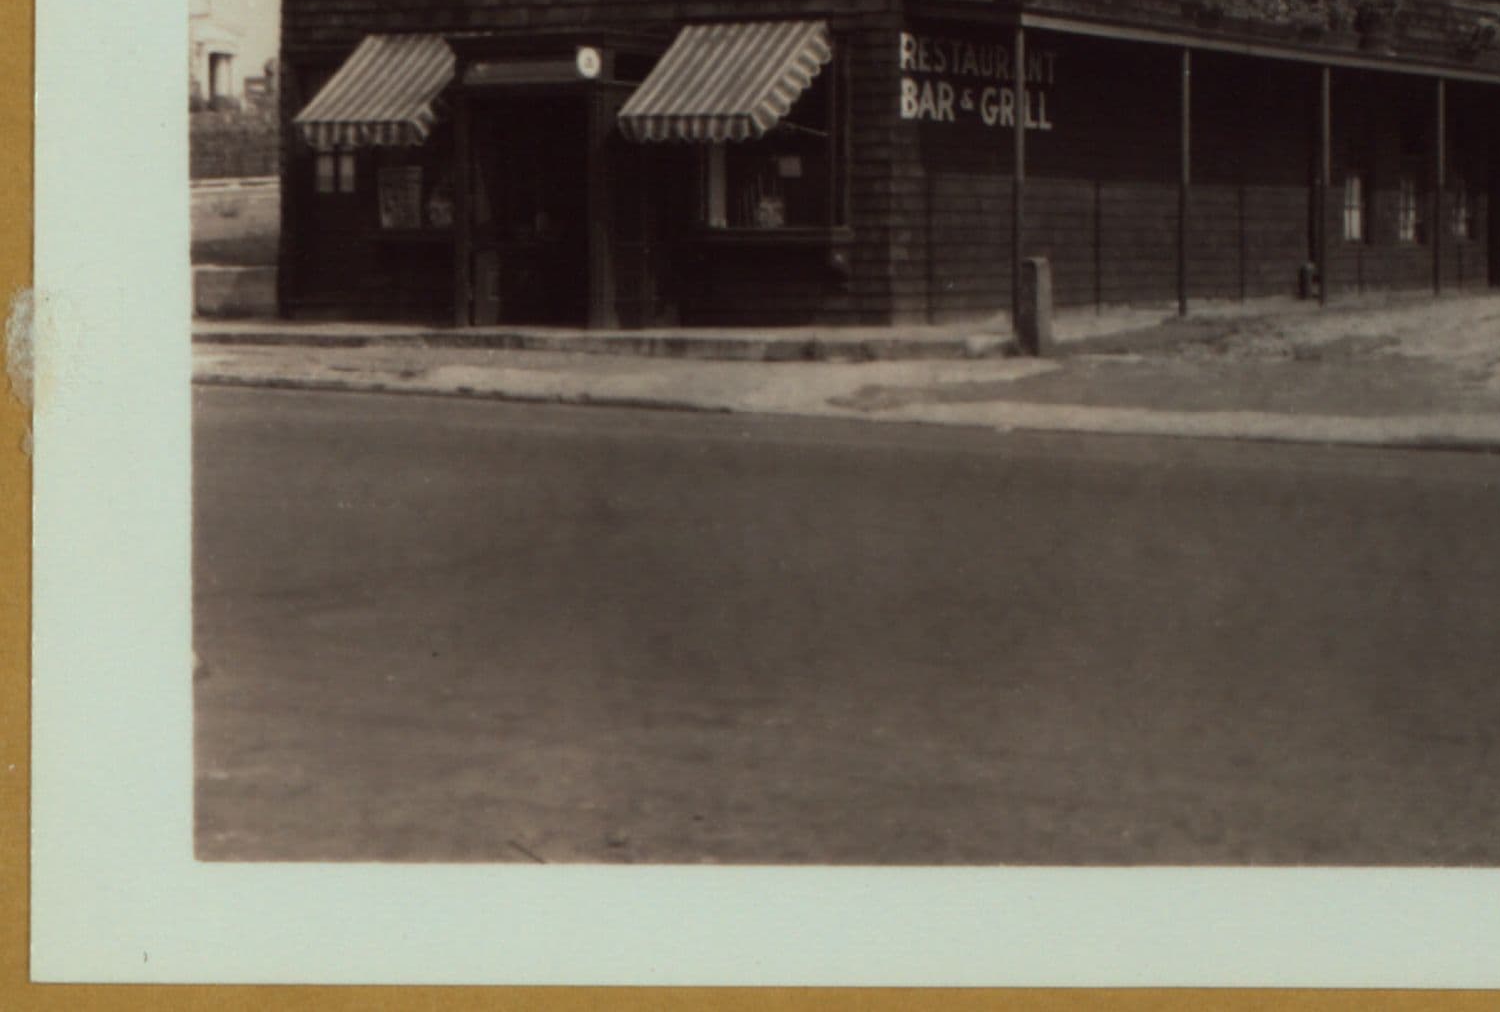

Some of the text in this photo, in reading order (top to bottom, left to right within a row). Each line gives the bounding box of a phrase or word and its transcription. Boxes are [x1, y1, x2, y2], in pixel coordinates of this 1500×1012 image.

[901, 76, 1052, 130] BAR & GRLL
